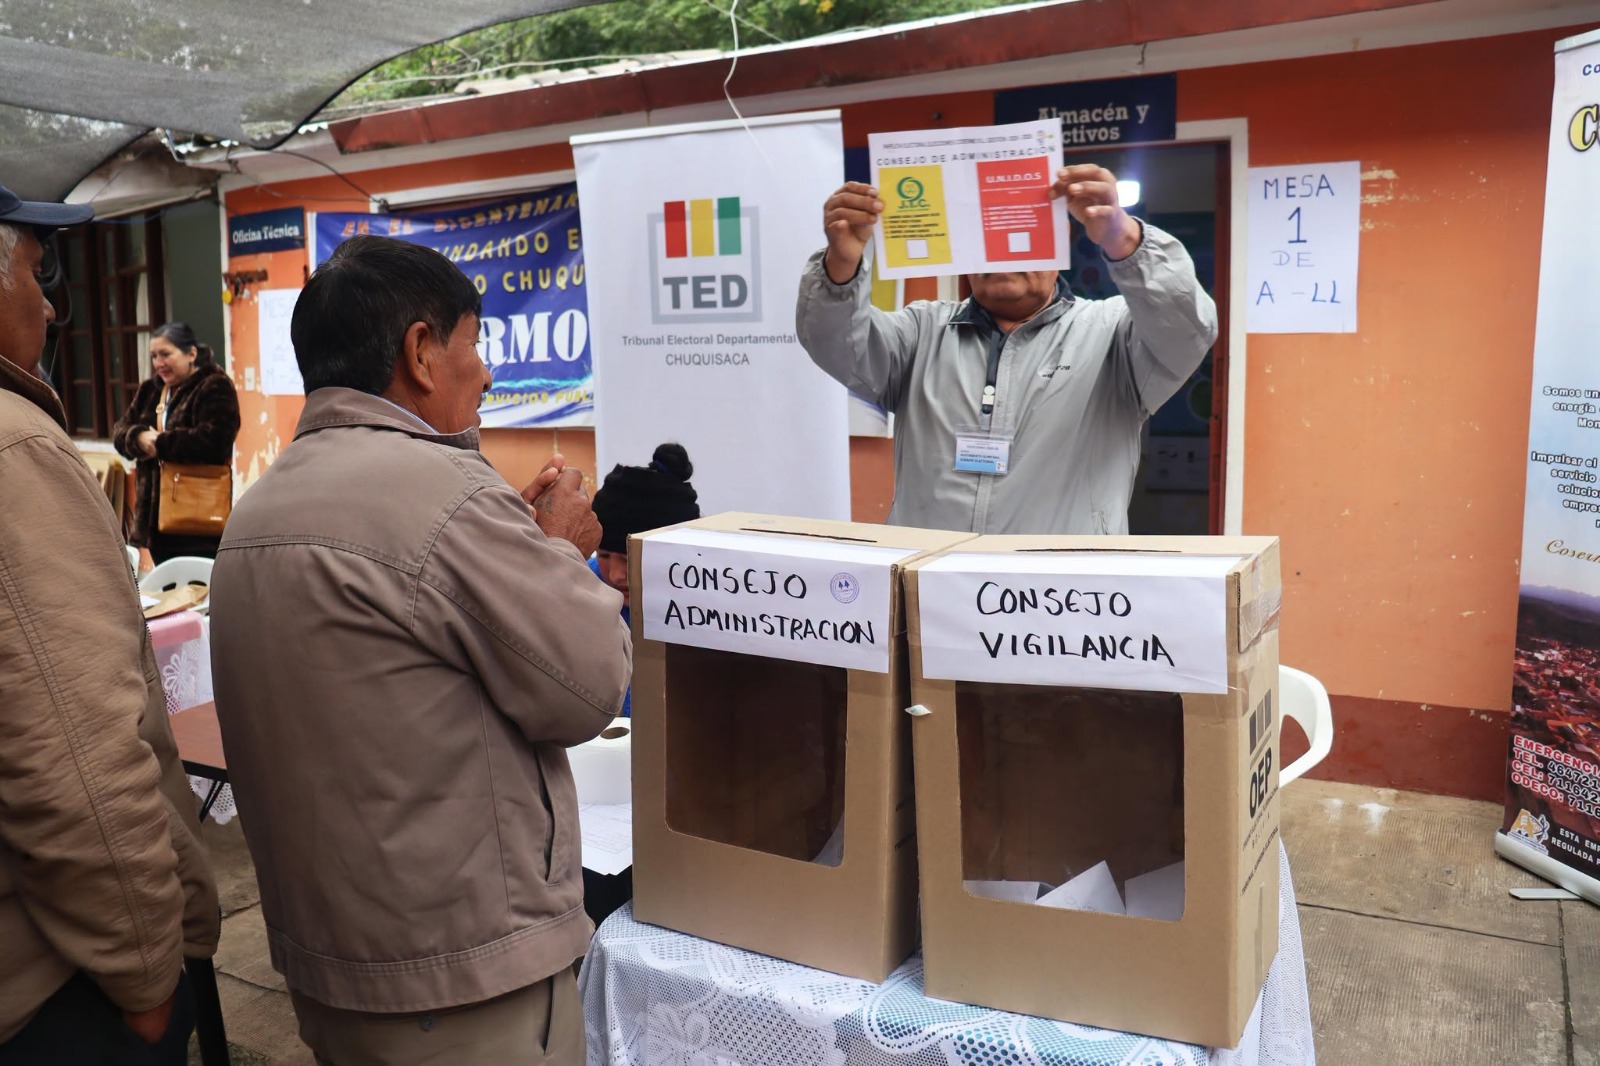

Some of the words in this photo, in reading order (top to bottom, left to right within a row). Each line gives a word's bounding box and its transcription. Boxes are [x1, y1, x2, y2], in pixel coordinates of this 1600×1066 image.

[1038, 102, 1129, 125] Almacén
[1135, 104, 1150, 124] y
[1061, 125, 1121, 144] ctivos
[1568, 104, 1600, 152] C
[876, 156, 926, 166] CONSEJO
[931, 154, 947, 163] DE
[1264, 174, 1335, 200] MESA
[232, 228, 261, 244] Oficina
[261, 223, 299, 240] Técnica
[1287, 206, 1307, 244] 1
[431, 231, 549, 263] INDANDO
[1272, 250, 1315, 268] DE
[662, 274, 748, 309] TED
[1256, 280, 1275, 306] A
[476, 309, 588, 366] RMO
[622, 335, 664, 346] Tribunal
[667, 334, 713, 345] Electoral
[716, 333, 797, 347] Departamental
[665, 353, 750, 366] CHUQUISACA
[484, 391, 549, 405] RVICIOS
[555, 389, 589, 404] PUBL
[1543, 386, 1581, 398] Somos
[1585, 389, 1600, 399] un
[1531, 451, 1583, 467] Impulsar
[1585, 457, 1598, 468] el
[1551, 469, 1597, 483] servicio
[1558, 484, 1600, 498] solucio
[668, 562, 807, 599] CONSEJO
[976, 581, 1132, 617] CONSEJO
[664, 600, 875, 645] ADMINISTRACION
[978, 631, 1175, 667] VIGILANCIA
[1512, 747, 1544, 768] TEL.
[1547, 760, 1600, 790] 464721
[1513, 735, 1600, 776] EMERGENCI
[1250, 747, 1272, 818] OEP
[1511, 759, 1544, 781] CEL:
[1548, 774, 1600, 804] 711642
[1511, 773, 1564, 802] ODECO:
[1559, 828, 1580, 844] ESTA
[1551, 837, 1594, 863] REGULADA
